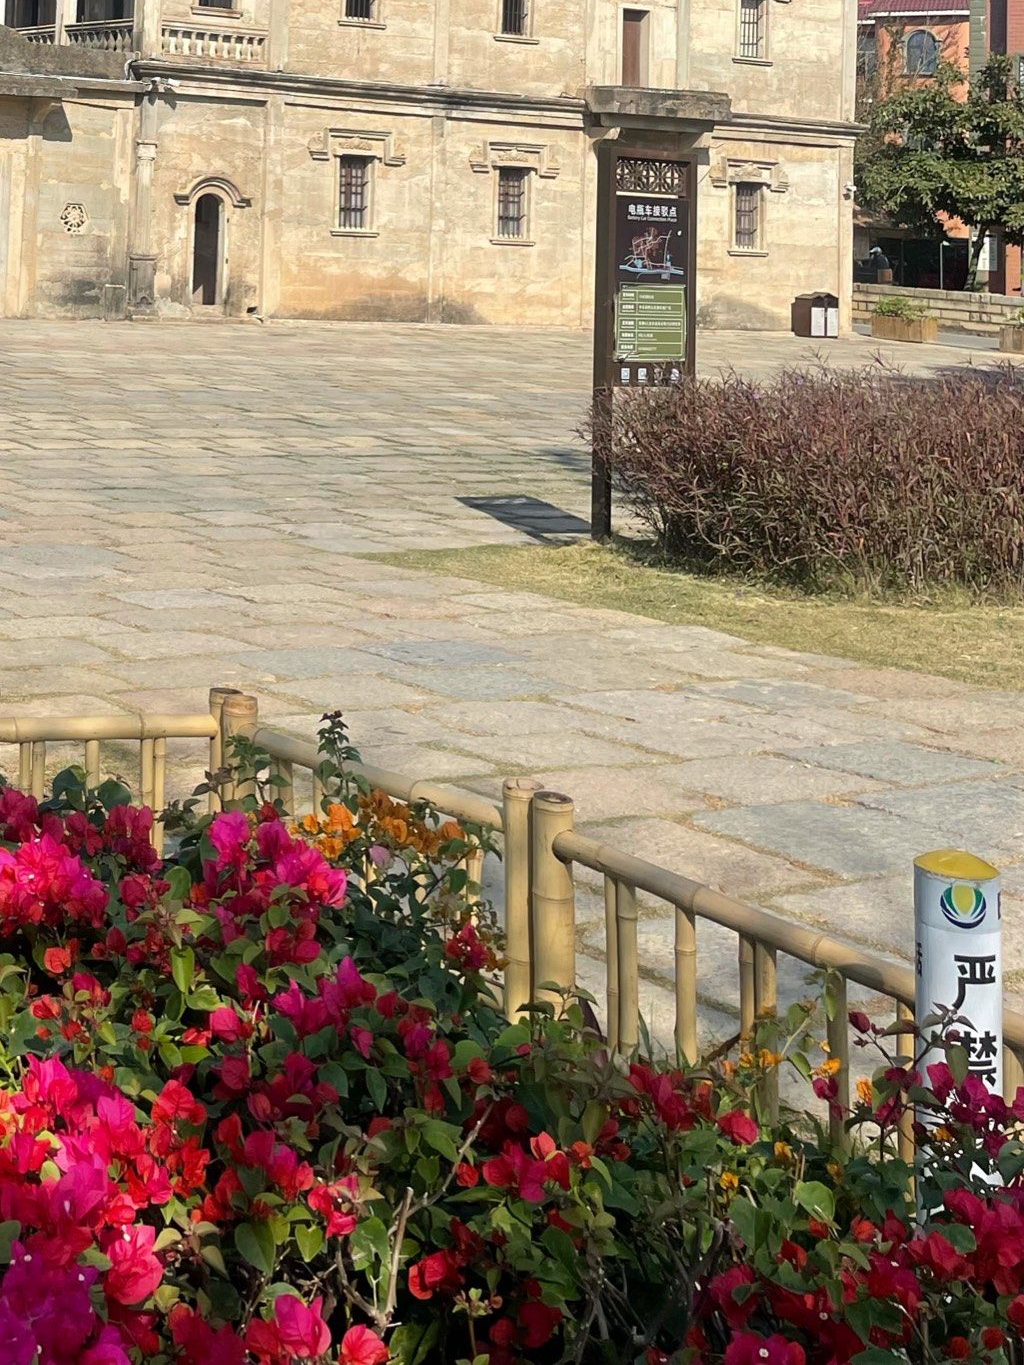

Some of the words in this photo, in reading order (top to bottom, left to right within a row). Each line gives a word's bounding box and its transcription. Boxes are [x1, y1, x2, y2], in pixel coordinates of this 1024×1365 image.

[628, 204, 677, 217] 电瓶车接驳点
